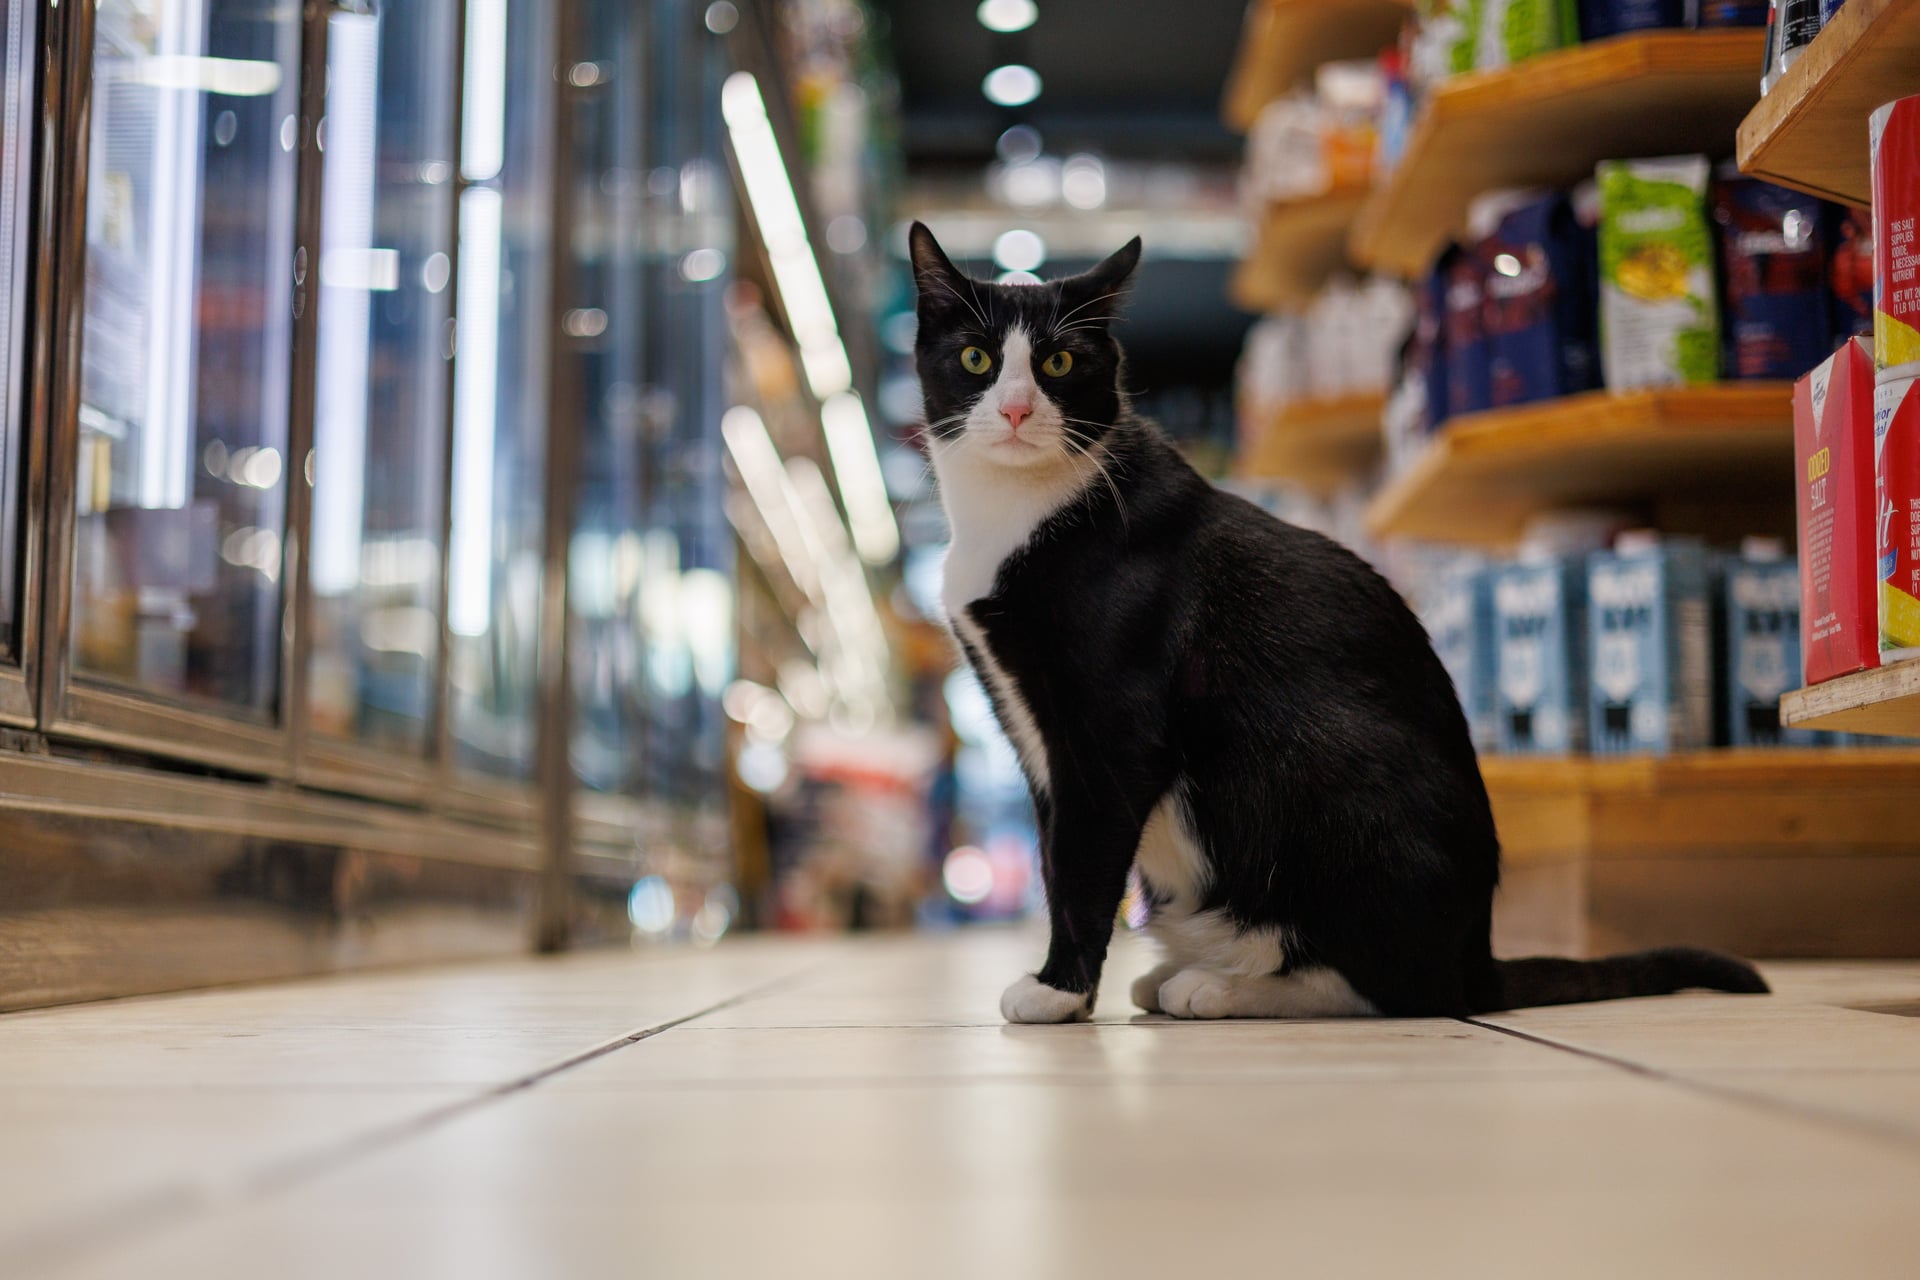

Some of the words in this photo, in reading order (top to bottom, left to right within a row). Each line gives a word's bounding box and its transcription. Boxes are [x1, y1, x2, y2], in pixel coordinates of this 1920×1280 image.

[1902, 218, 1914, 231] SALT
[1891, 230, 1914, 246] SUPPLIES
[1892, 268, 1915, 283] NUTRIENT
[1893, 290, 1903, 303] NET
[1904, 288, 1913, 300] WT
[1899, 302, 1907, 314] LB
[1811, 478, 1826, 510] SALT
